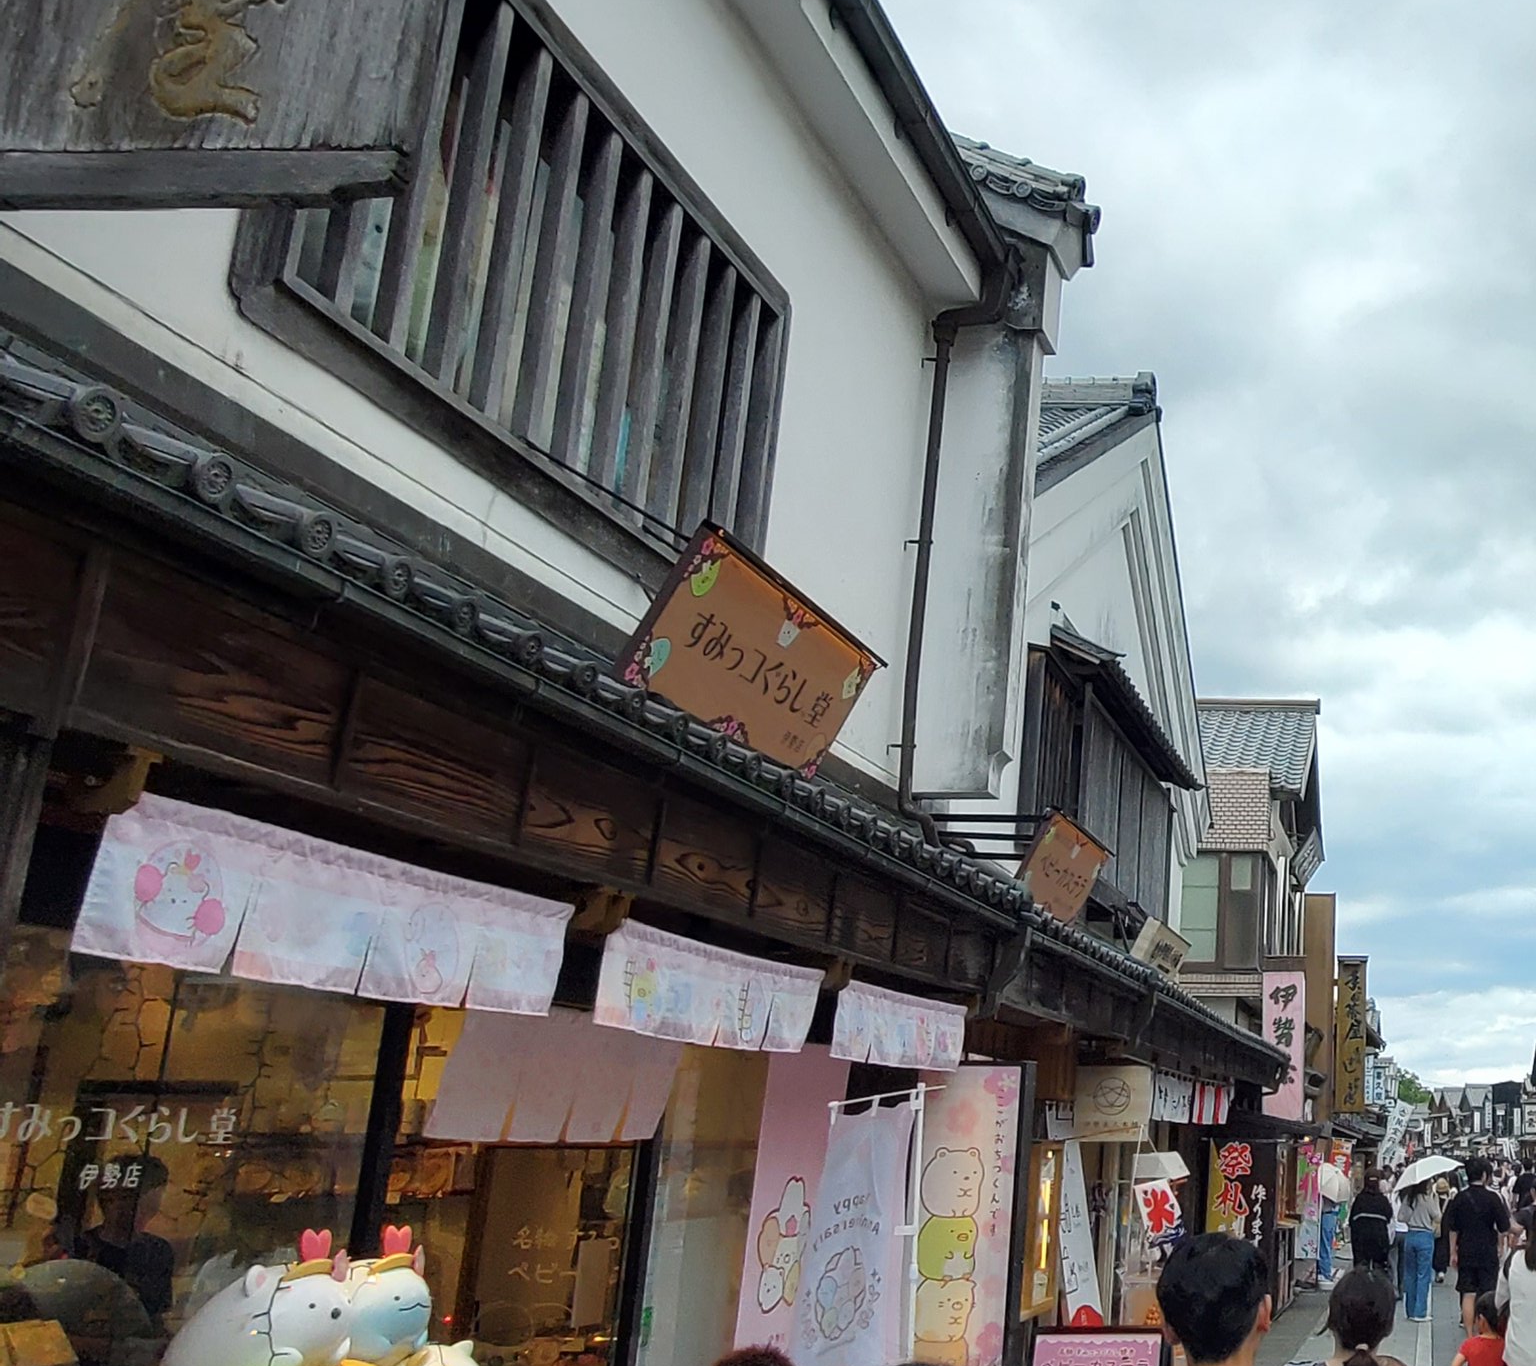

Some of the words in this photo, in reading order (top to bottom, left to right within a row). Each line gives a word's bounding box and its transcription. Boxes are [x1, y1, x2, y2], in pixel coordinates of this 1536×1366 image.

[684, 612, 834, 728] すみっコぐらし堂
[0, 1101, 238, 1144] すみっコぐらし堂
[79, 1164, 142, 1190] 伊勢店
[1143, 1191, 1174, 1235] 氷
